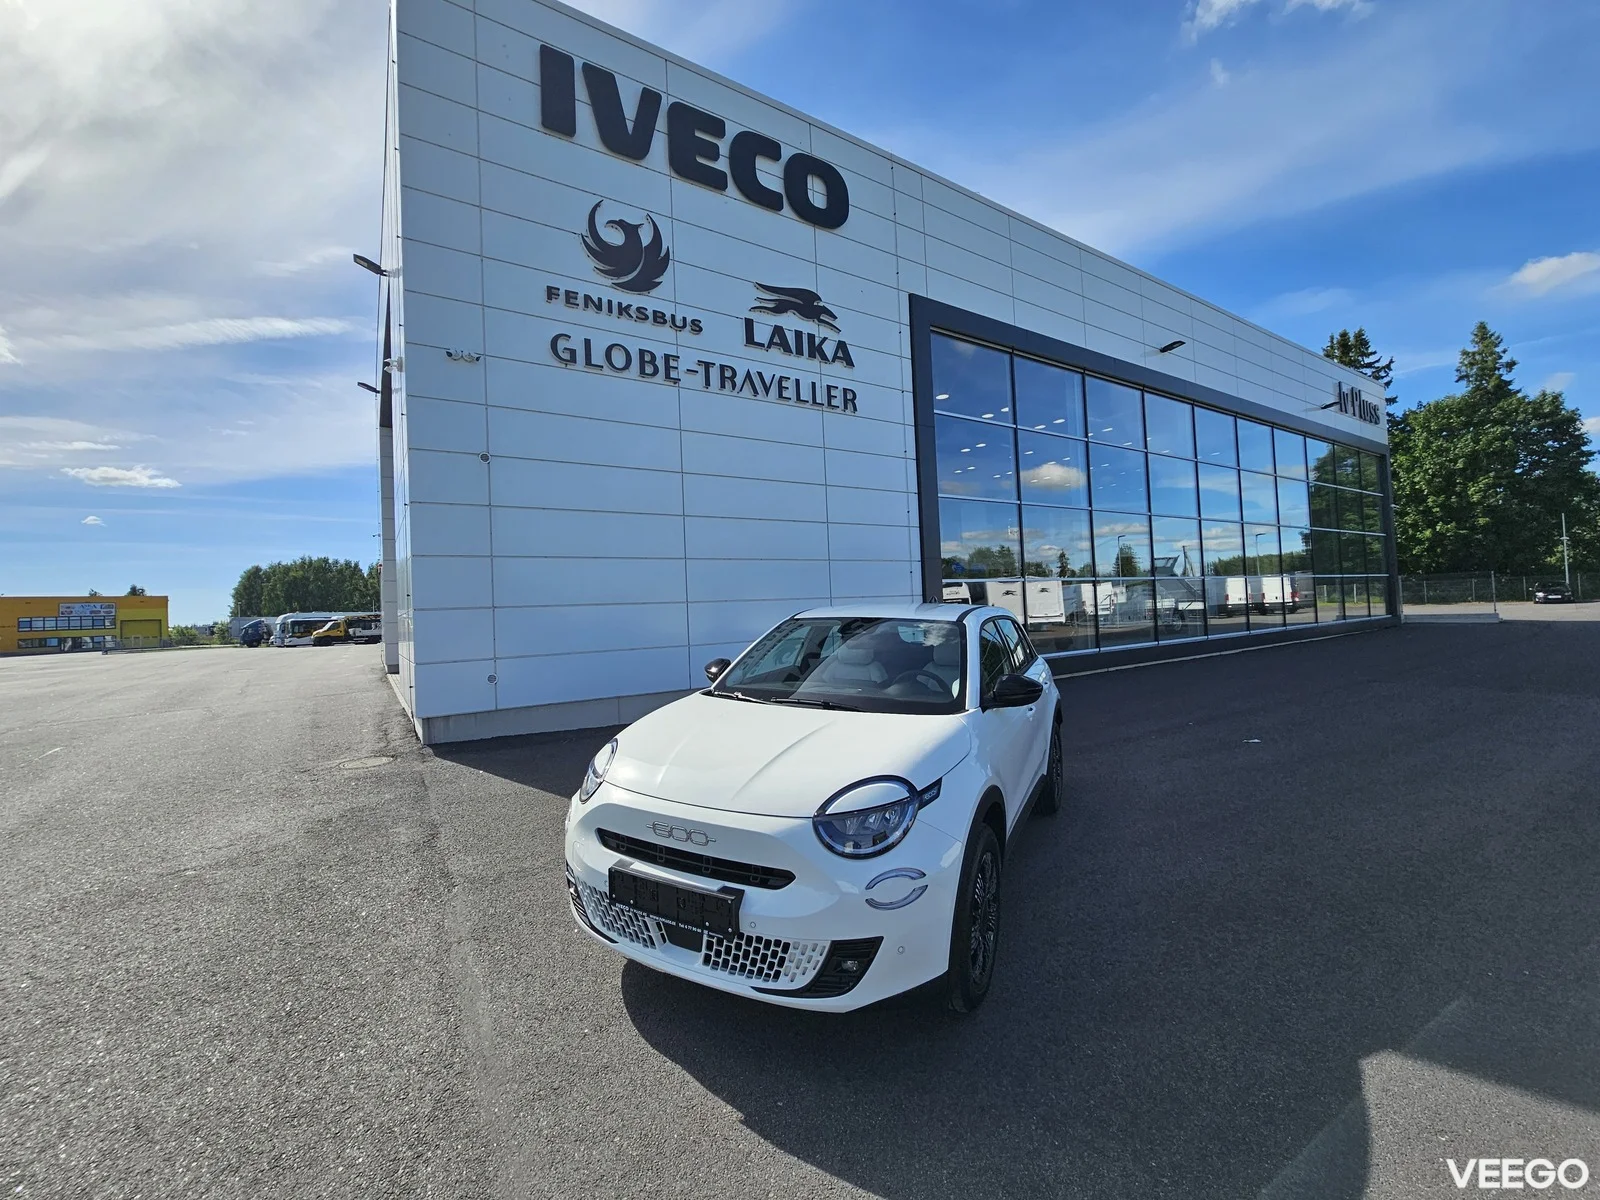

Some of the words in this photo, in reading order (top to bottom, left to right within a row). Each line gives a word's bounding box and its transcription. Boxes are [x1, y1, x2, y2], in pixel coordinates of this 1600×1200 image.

[540, 44, 849, 229] IVECO
[546, 285, 704, 335] FENIKSBUS
[744, 317, 855, 368] LAIKA
[550, 333, 858, 413] GLOBE-TRAVELLER
[652, 820, 710, 847] 600
